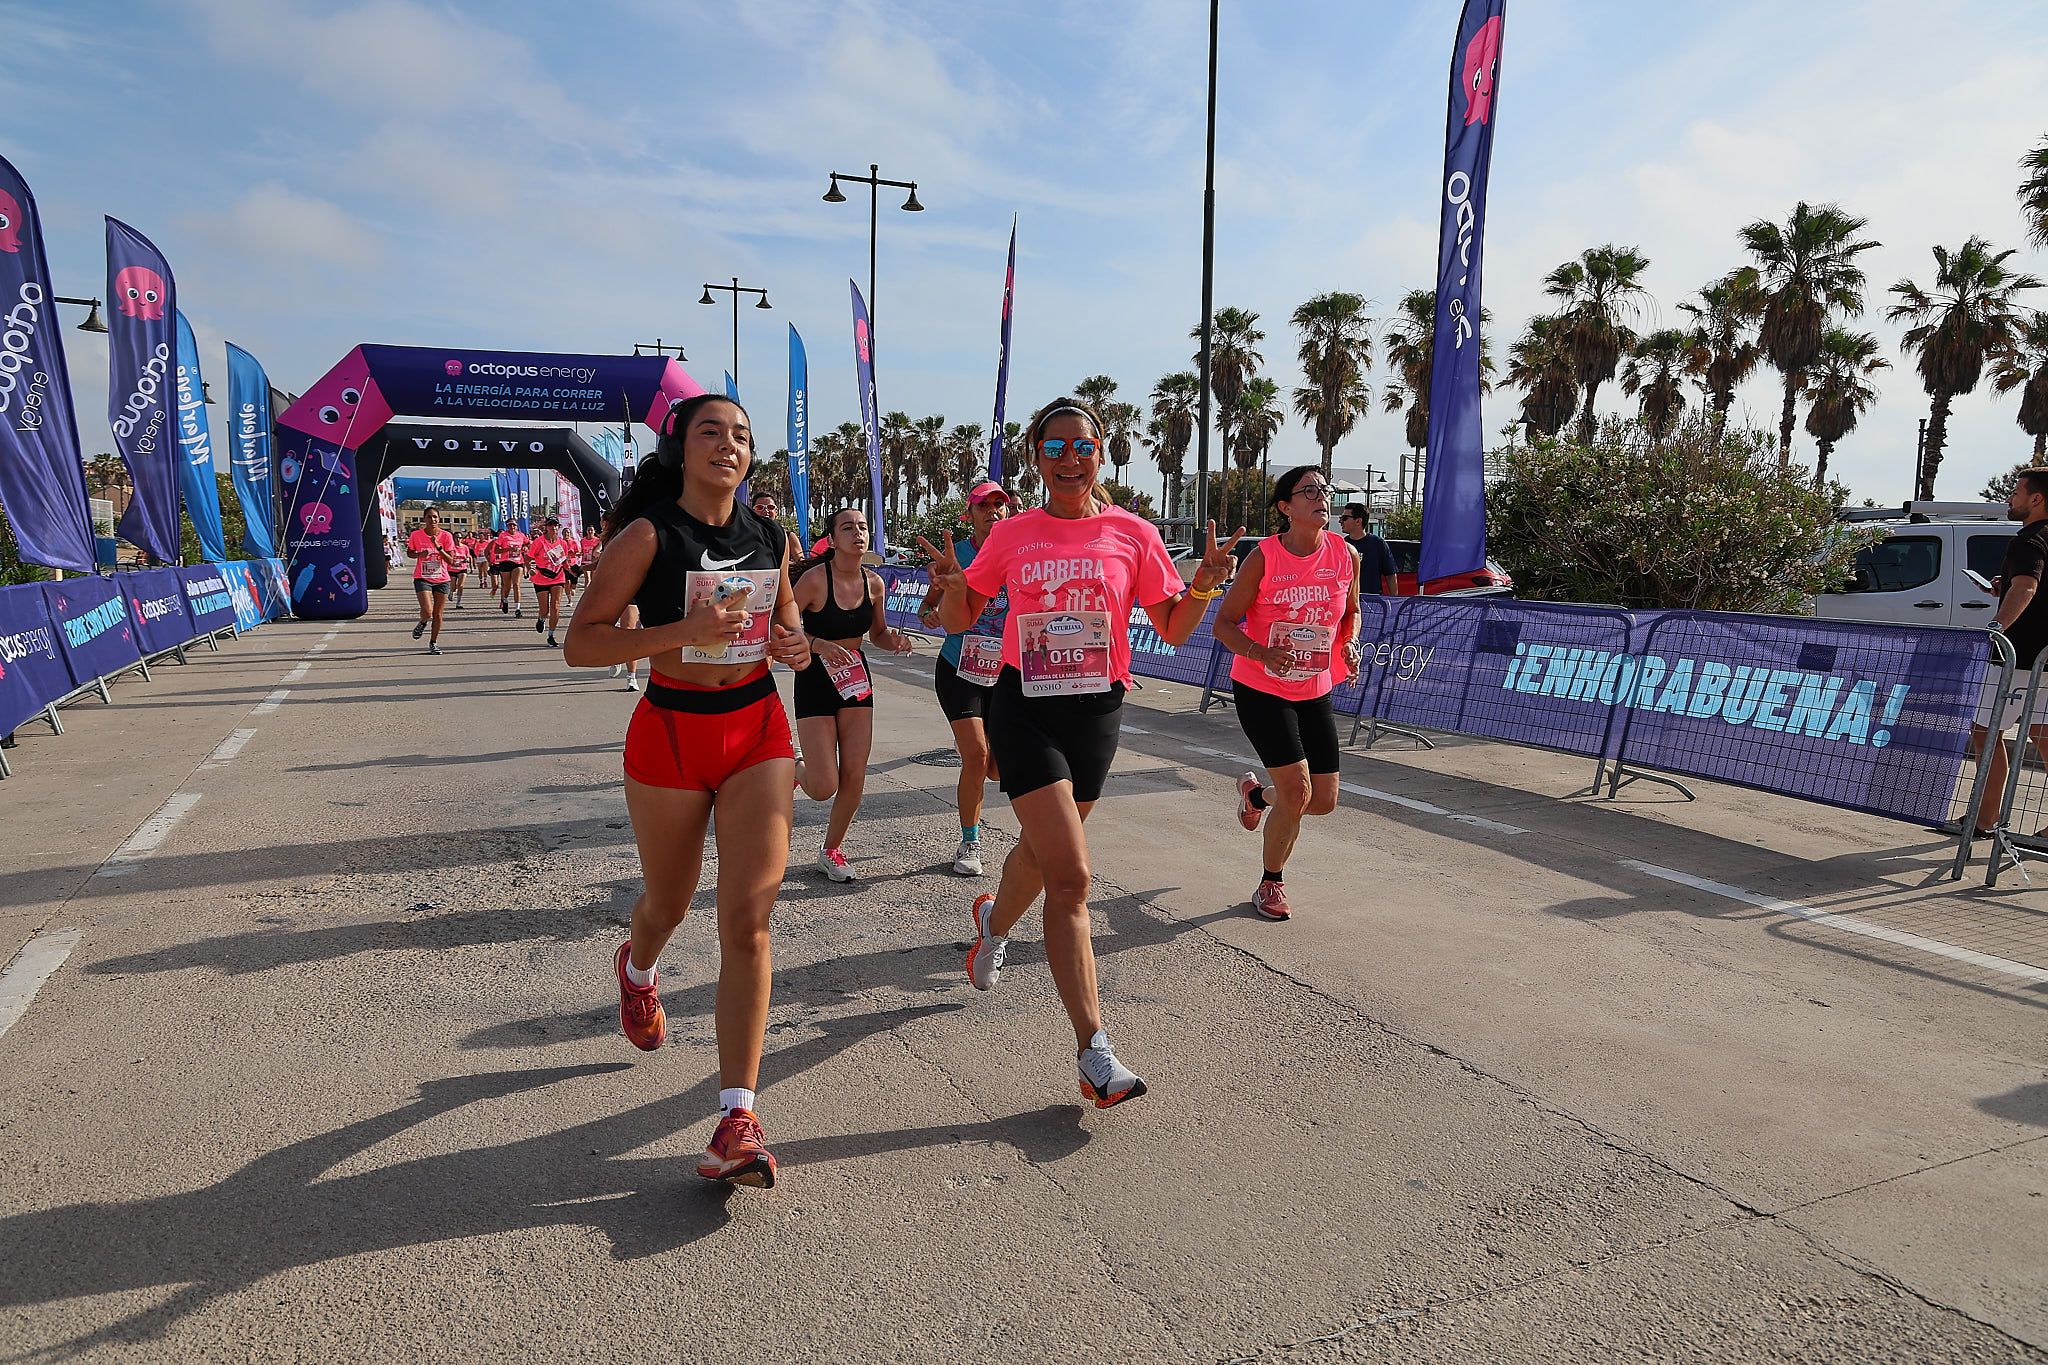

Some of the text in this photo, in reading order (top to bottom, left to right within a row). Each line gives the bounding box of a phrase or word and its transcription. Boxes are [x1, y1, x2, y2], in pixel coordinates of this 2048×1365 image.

[469, 362, 597, 384] octopus energy
[435, 383, 603, 399] LA ENERGÍA PARA CORRER
[434, 397, 606, 411] A LA VELOCIDAD DE LA LUZ
[411, 437, 545, 453] VOLVO
[290, 539, 351, 549] octopus energy
[1017, 542, 1054, 555] OYSHO
[1021, 558, 1105, 585] CARRERA
[1271, 573, 1298, 582] OYSHO
[1273, 585, 1331, 604] CARRERA
[977, 659, 998, 669] 016
[1050, 649, 1085, 664] 016
[1360, 642, 1435, 682] nergy
[831, 669, 852, 684] 016
[1032, 683, 1062, 692] OYSHO
[1503, 642, 1911, 748] ¡ENHORABUENA!
